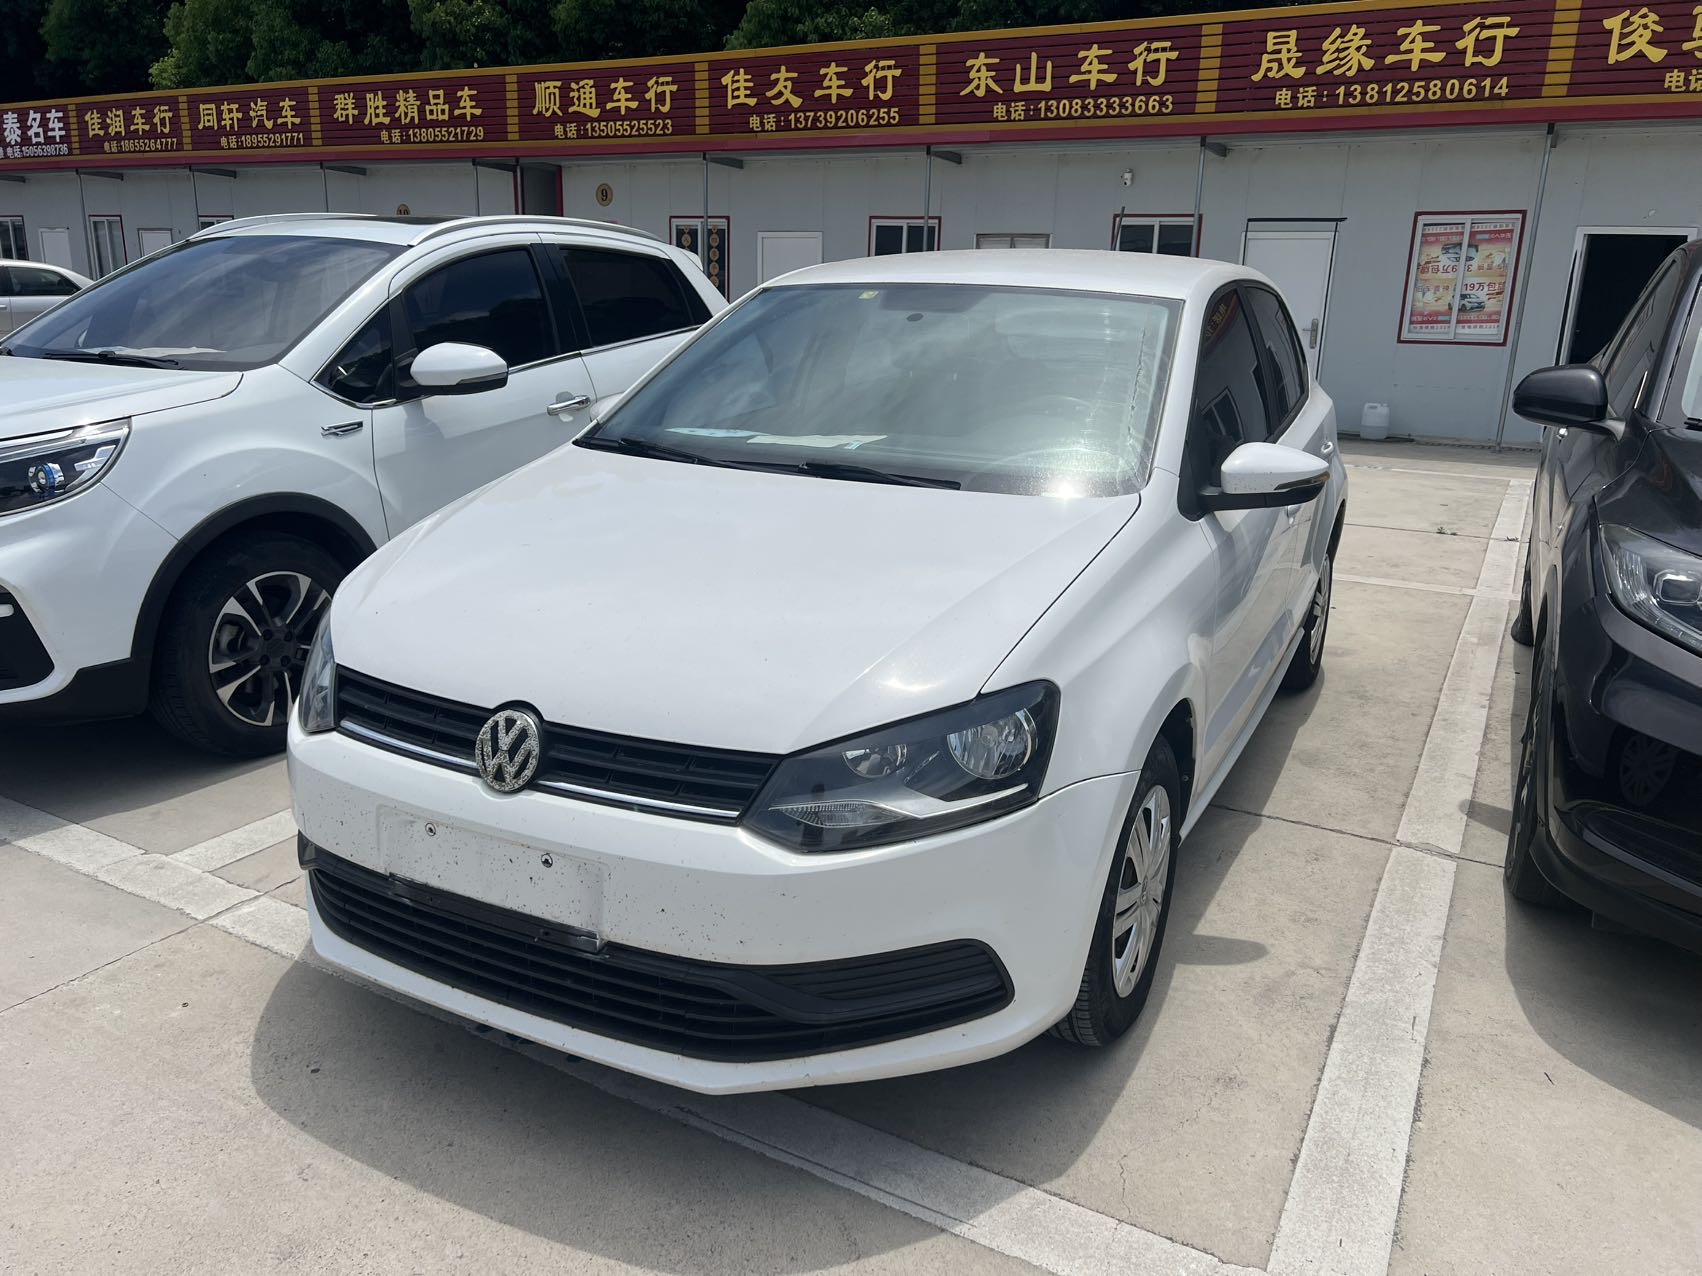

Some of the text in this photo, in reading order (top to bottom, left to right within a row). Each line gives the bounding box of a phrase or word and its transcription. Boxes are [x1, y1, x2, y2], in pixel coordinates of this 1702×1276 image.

[960, 41, 1180, 97] 东山车行
[1251, 16, 1521, 82] 晟缘车行
[532, 76, 678, 118] 顺通车行
[721, 59, 902, 109] 佳友车行
[85, 105, 173, 138] 佳润车行
[198, 97, 301, 132] 同轩汽车
[333, 86, 483, 126] 群胜精品车
[3, 109, 66, 146] 泰名车
